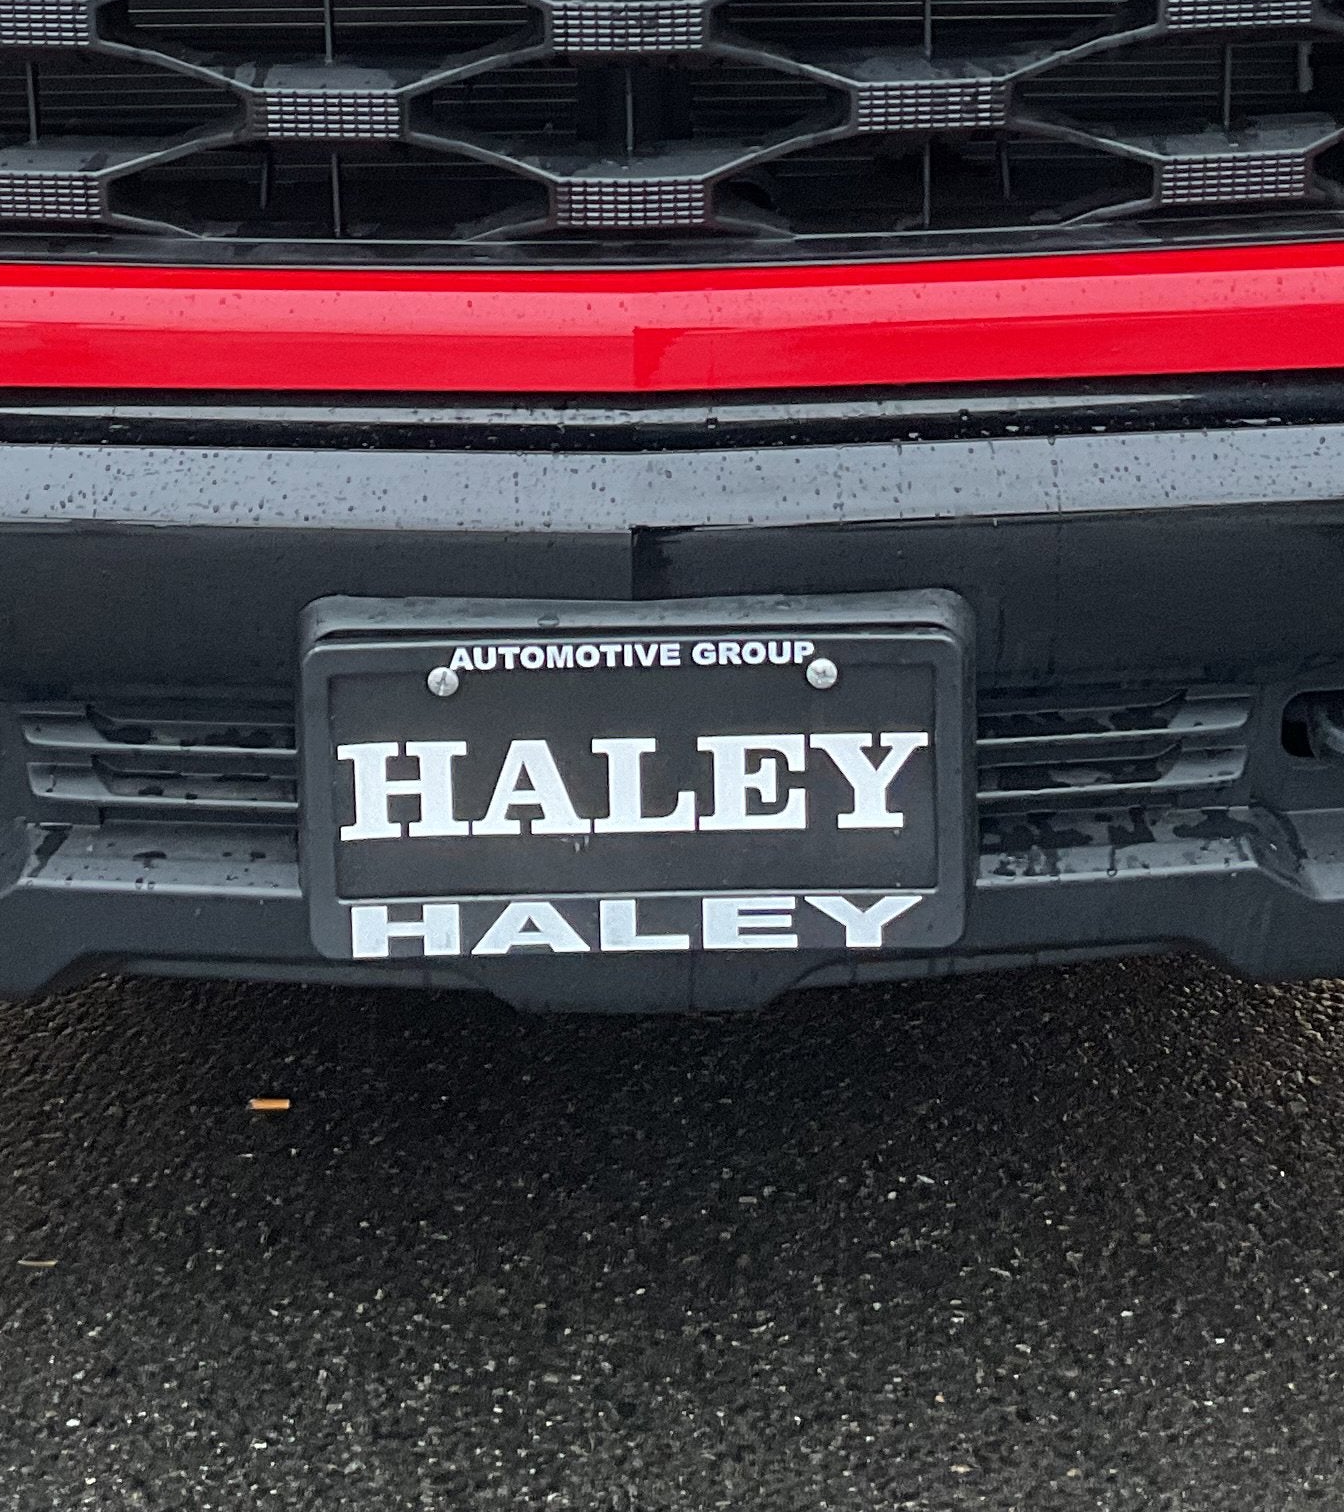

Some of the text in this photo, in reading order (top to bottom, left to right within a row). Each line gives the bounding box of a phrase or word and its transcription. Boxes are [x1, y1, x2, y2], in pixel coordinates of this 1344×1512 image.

[450, 640, 816, 671] AUTOMOTIVE GROUP
[337, 731, 929, 842] HALEY
[351, 895, 923, 958] HALEY
